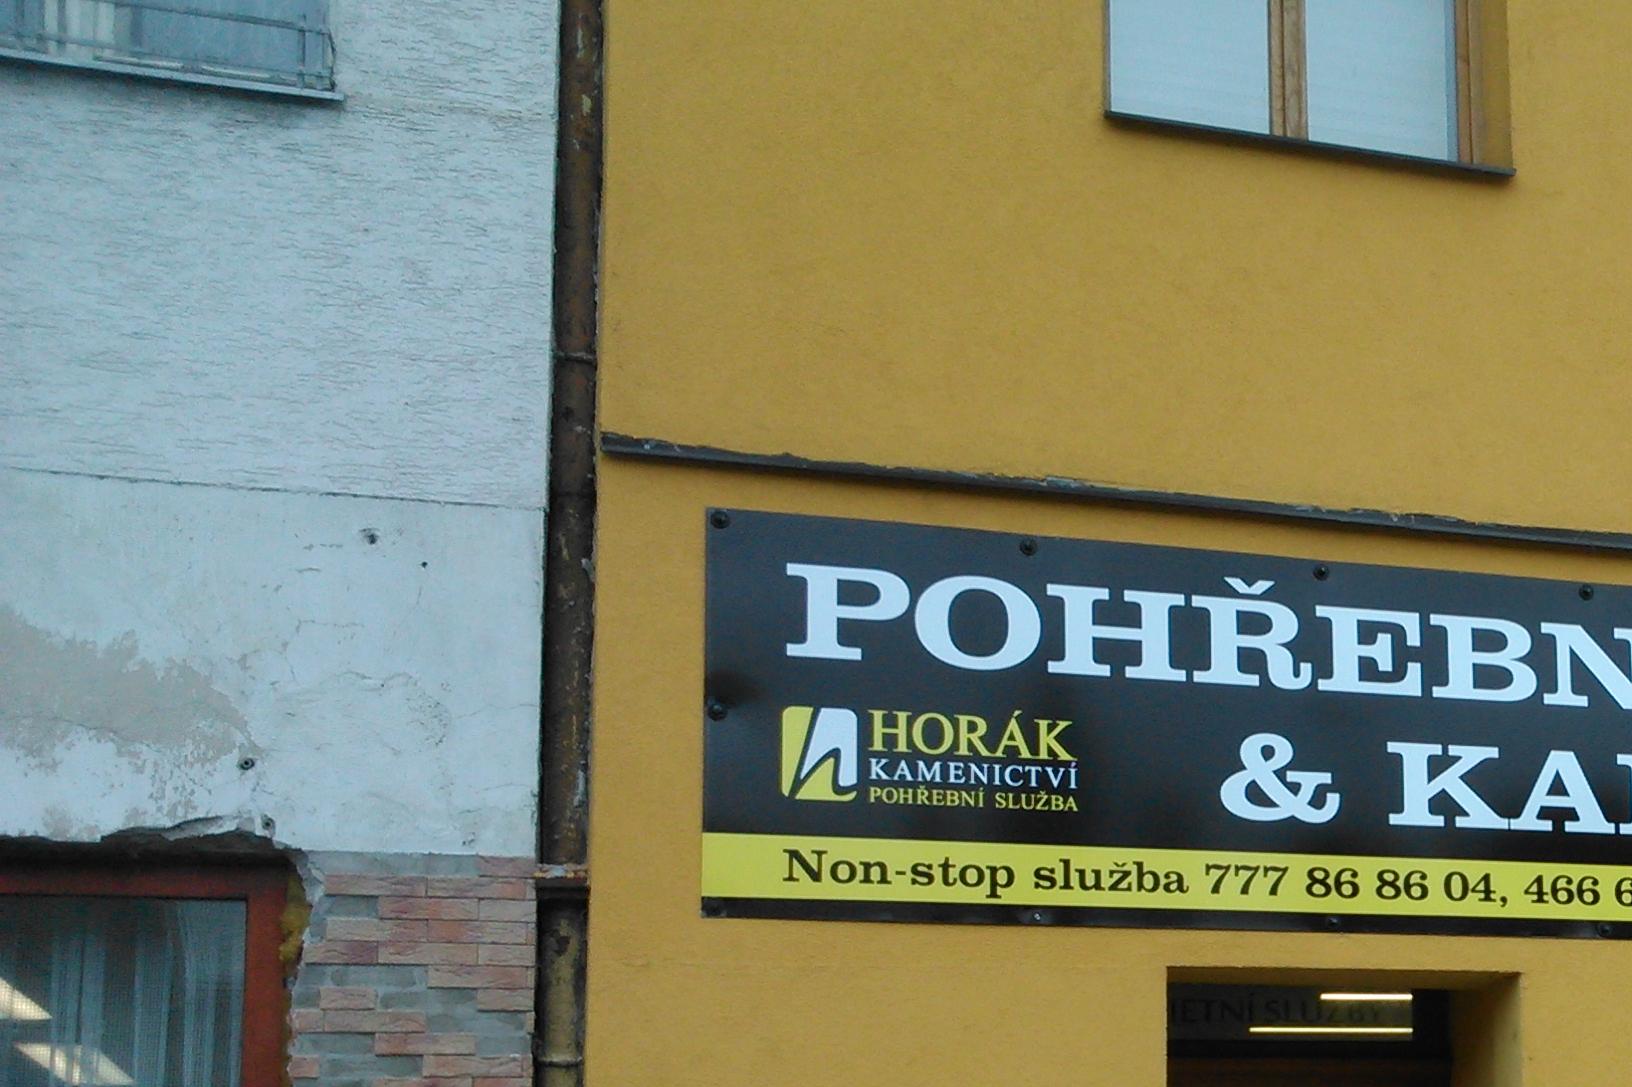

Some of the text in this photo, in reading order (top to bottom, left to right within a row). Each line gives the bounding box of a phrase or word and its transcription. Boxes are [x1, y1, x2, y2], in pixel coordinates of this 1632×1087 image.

[867, 709, 1078, 762] HORÁK
[868, 757, 1079, 789] KAMENICTVÍ
[868, 785, 1079, 812] POHŘEBNÍ SLUŽBA
[1219, 732, 1341, 824] &
[782, 849, 1016, 899] Non-stop
[1033, 858, 1189, 895] služba
[1204, 862, 1289, 896] 777
[1305, 866, 1360, 899] 86
[1375, 869, 1429, 901] 86
[1443, 871, 1509, 908] 04,
[1523, 873, 1601, 906] 466
